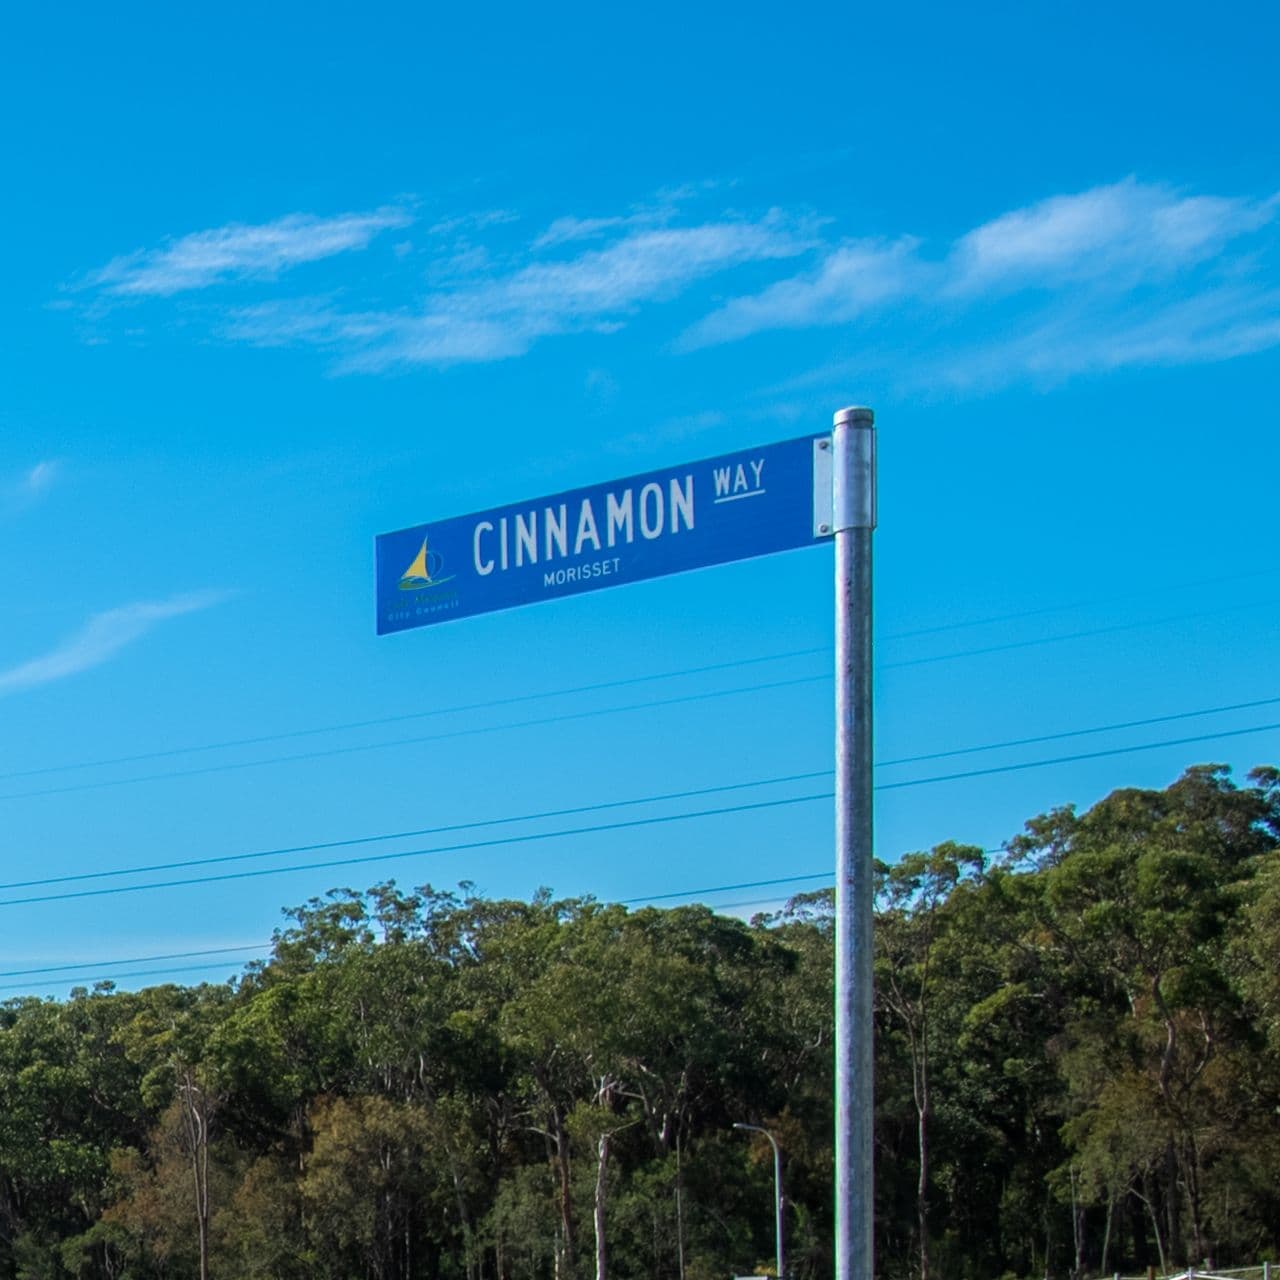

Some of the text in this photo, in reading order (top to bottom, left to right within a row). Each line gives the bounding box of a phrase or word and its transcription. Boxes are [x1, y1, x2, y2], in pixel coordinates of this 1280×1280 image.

[472, 458, 766, 576] CINNAMON WAY
[543, 557, 620, 588] MORISSET
